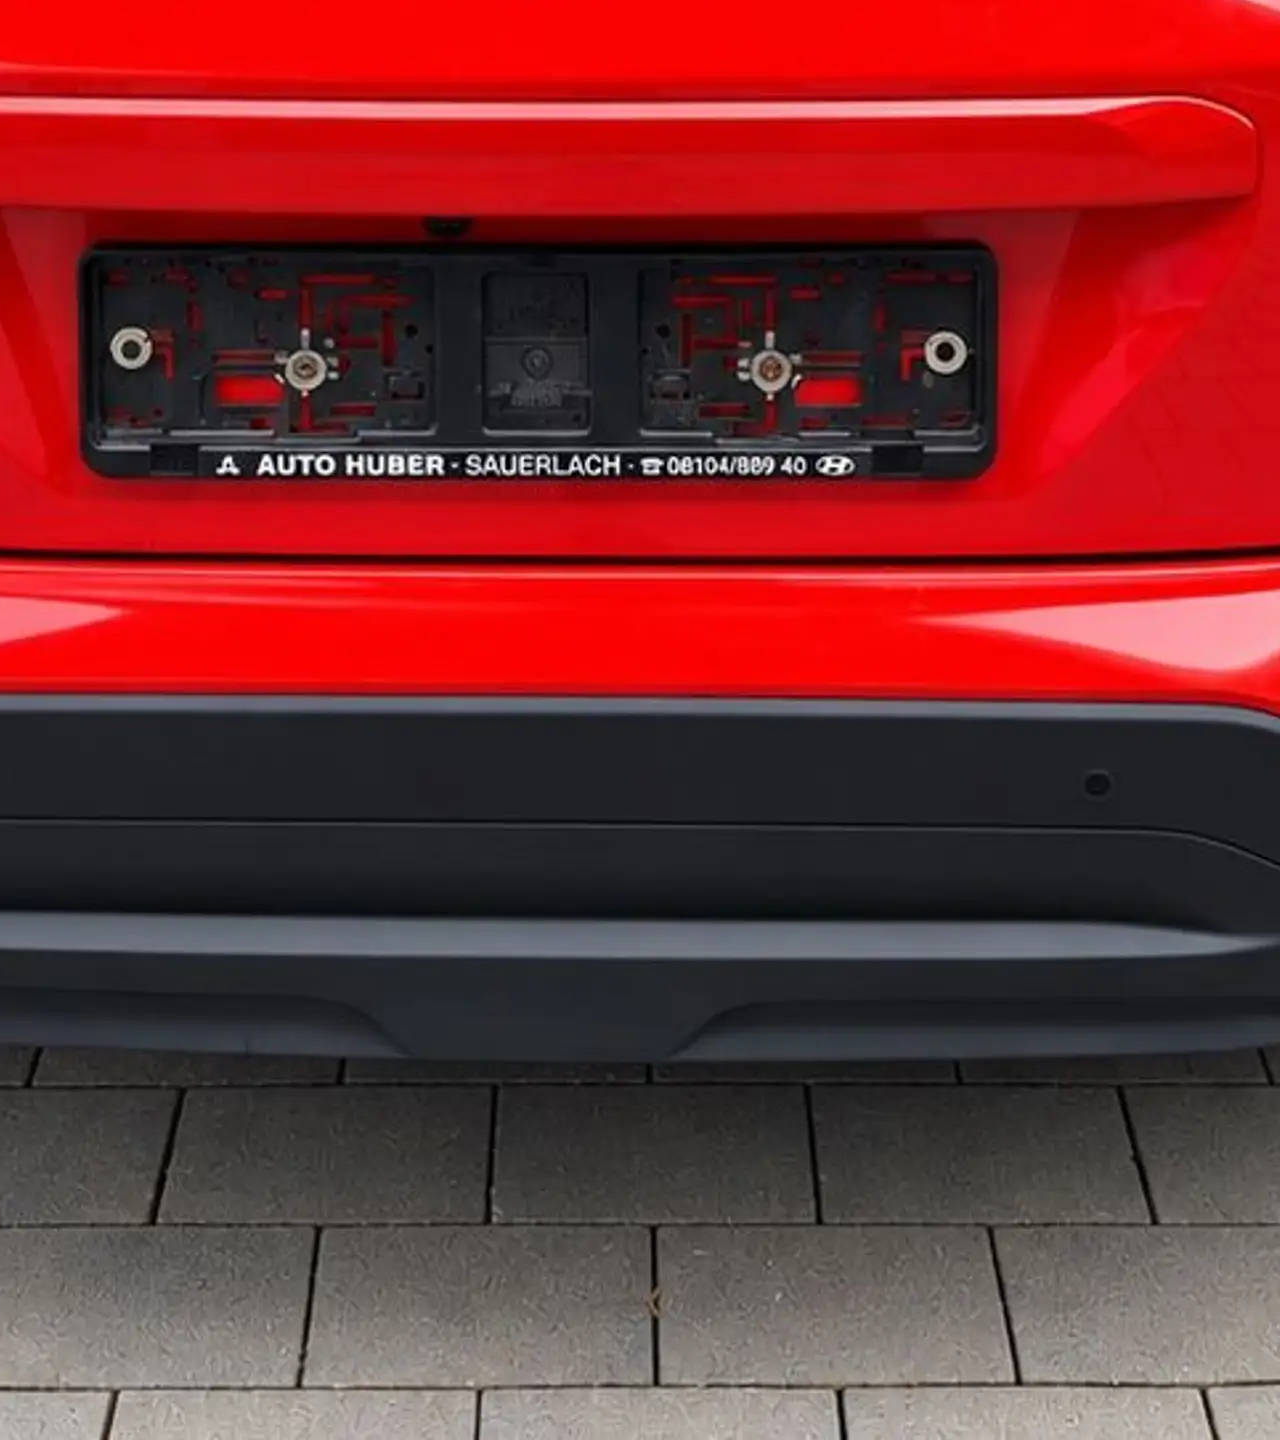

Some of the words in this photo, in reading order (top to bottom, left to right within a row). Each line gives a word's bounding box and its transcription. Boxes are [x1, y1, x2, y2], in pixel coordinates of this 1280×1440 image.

[256, 454, 335, 476] AUTO
[345, 454, 445, 476] HUBER
[465, 454, 621, 476] SAUERLACH
